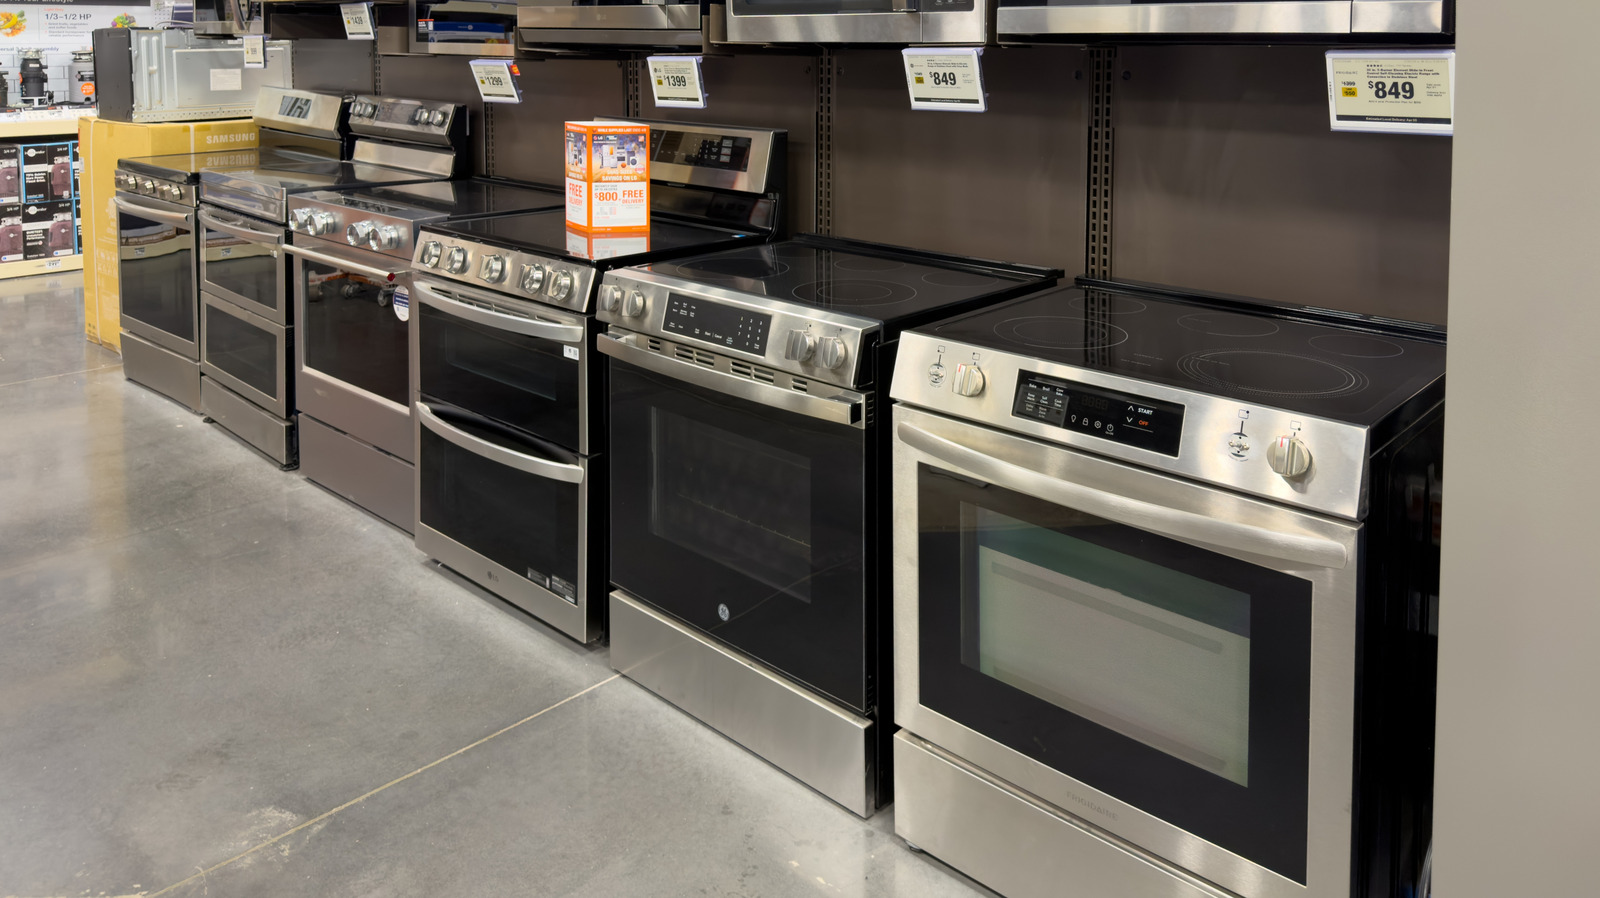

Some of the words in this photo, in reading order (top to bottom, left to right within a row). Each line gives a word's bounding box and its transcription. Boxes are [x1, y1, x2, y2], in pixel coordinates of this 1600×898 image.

[664, 75, 687, 86] $1399
[929, 72, 956, 86] $849
[1368, 80, 1414, 99] $849
[206, 132, 255, 144] SAMSUNG
[569, 183, 582, 198] FREE
[594, 192, 618, 201] $800
[622, 190, 644, 198] FREE
[1138, 408, 1153, 416] START
[1066, 790, 1119, 822] FRIGIDAIRE
